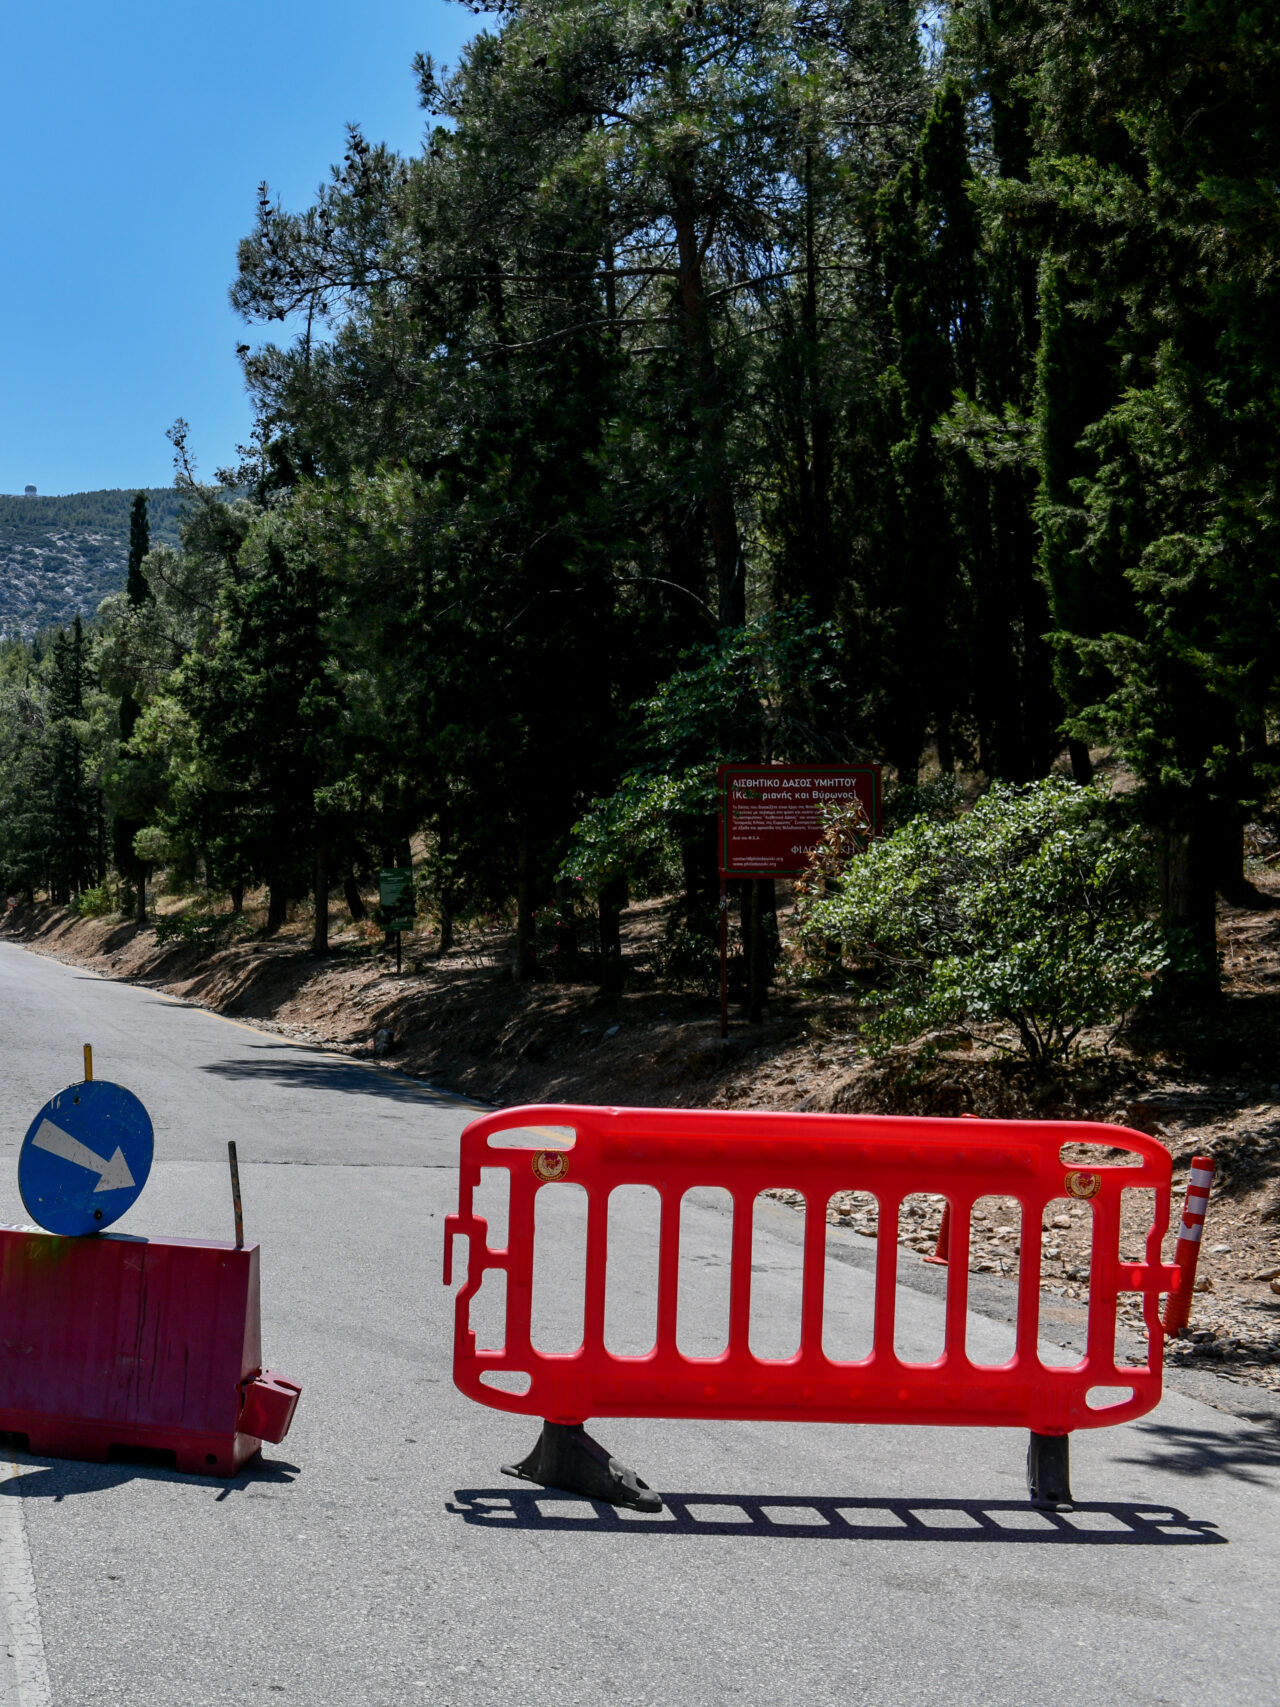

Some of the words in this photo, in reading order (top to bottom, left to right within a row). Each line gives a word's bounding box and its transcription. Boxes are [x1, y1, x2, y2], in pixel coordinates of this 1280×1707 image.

[732, 778, 780, 787] ΑΙΣΘΗΤΙΚΟ
[782, 778, 812, 787] ΔΑΣΟΣ
[814, 778, 856, 787] ΥΜΗΤΤΟΥ
